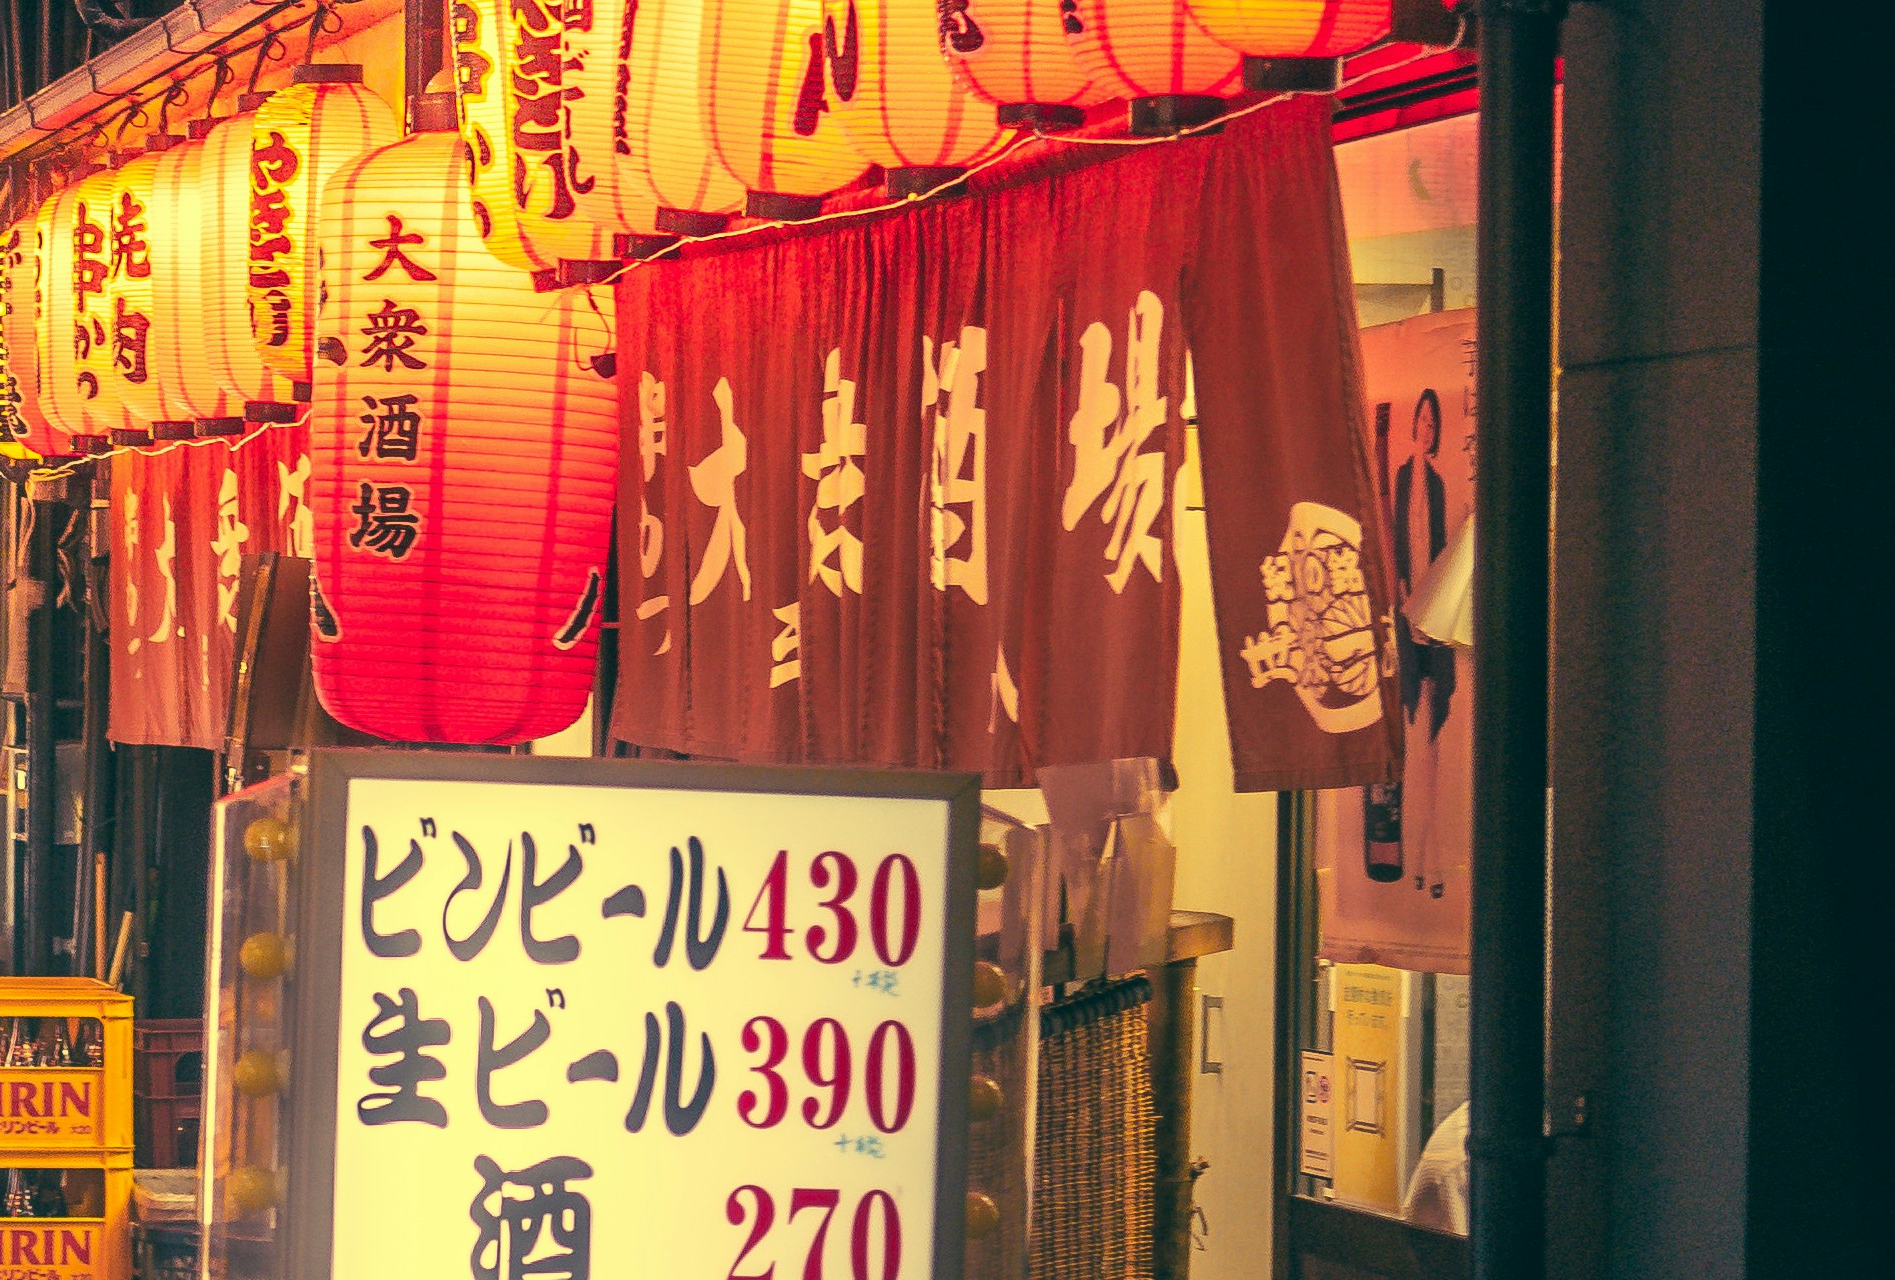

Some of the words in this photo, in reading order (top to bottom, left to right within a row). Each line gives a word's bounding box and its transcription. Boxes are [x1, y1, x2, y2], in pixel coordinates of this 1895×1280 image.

[74, 202, 108, 400] 串かつ
[111, 191, 151, 384] 焼肉
[348, 215, 437, 560] 大衆酒場
[359, 815, 731, 972] ビンビール
[741, 849, 924, 970] 430
[356, 986, 717, 1138] 生ビール
[735, 1014, 918, 1135] 390
